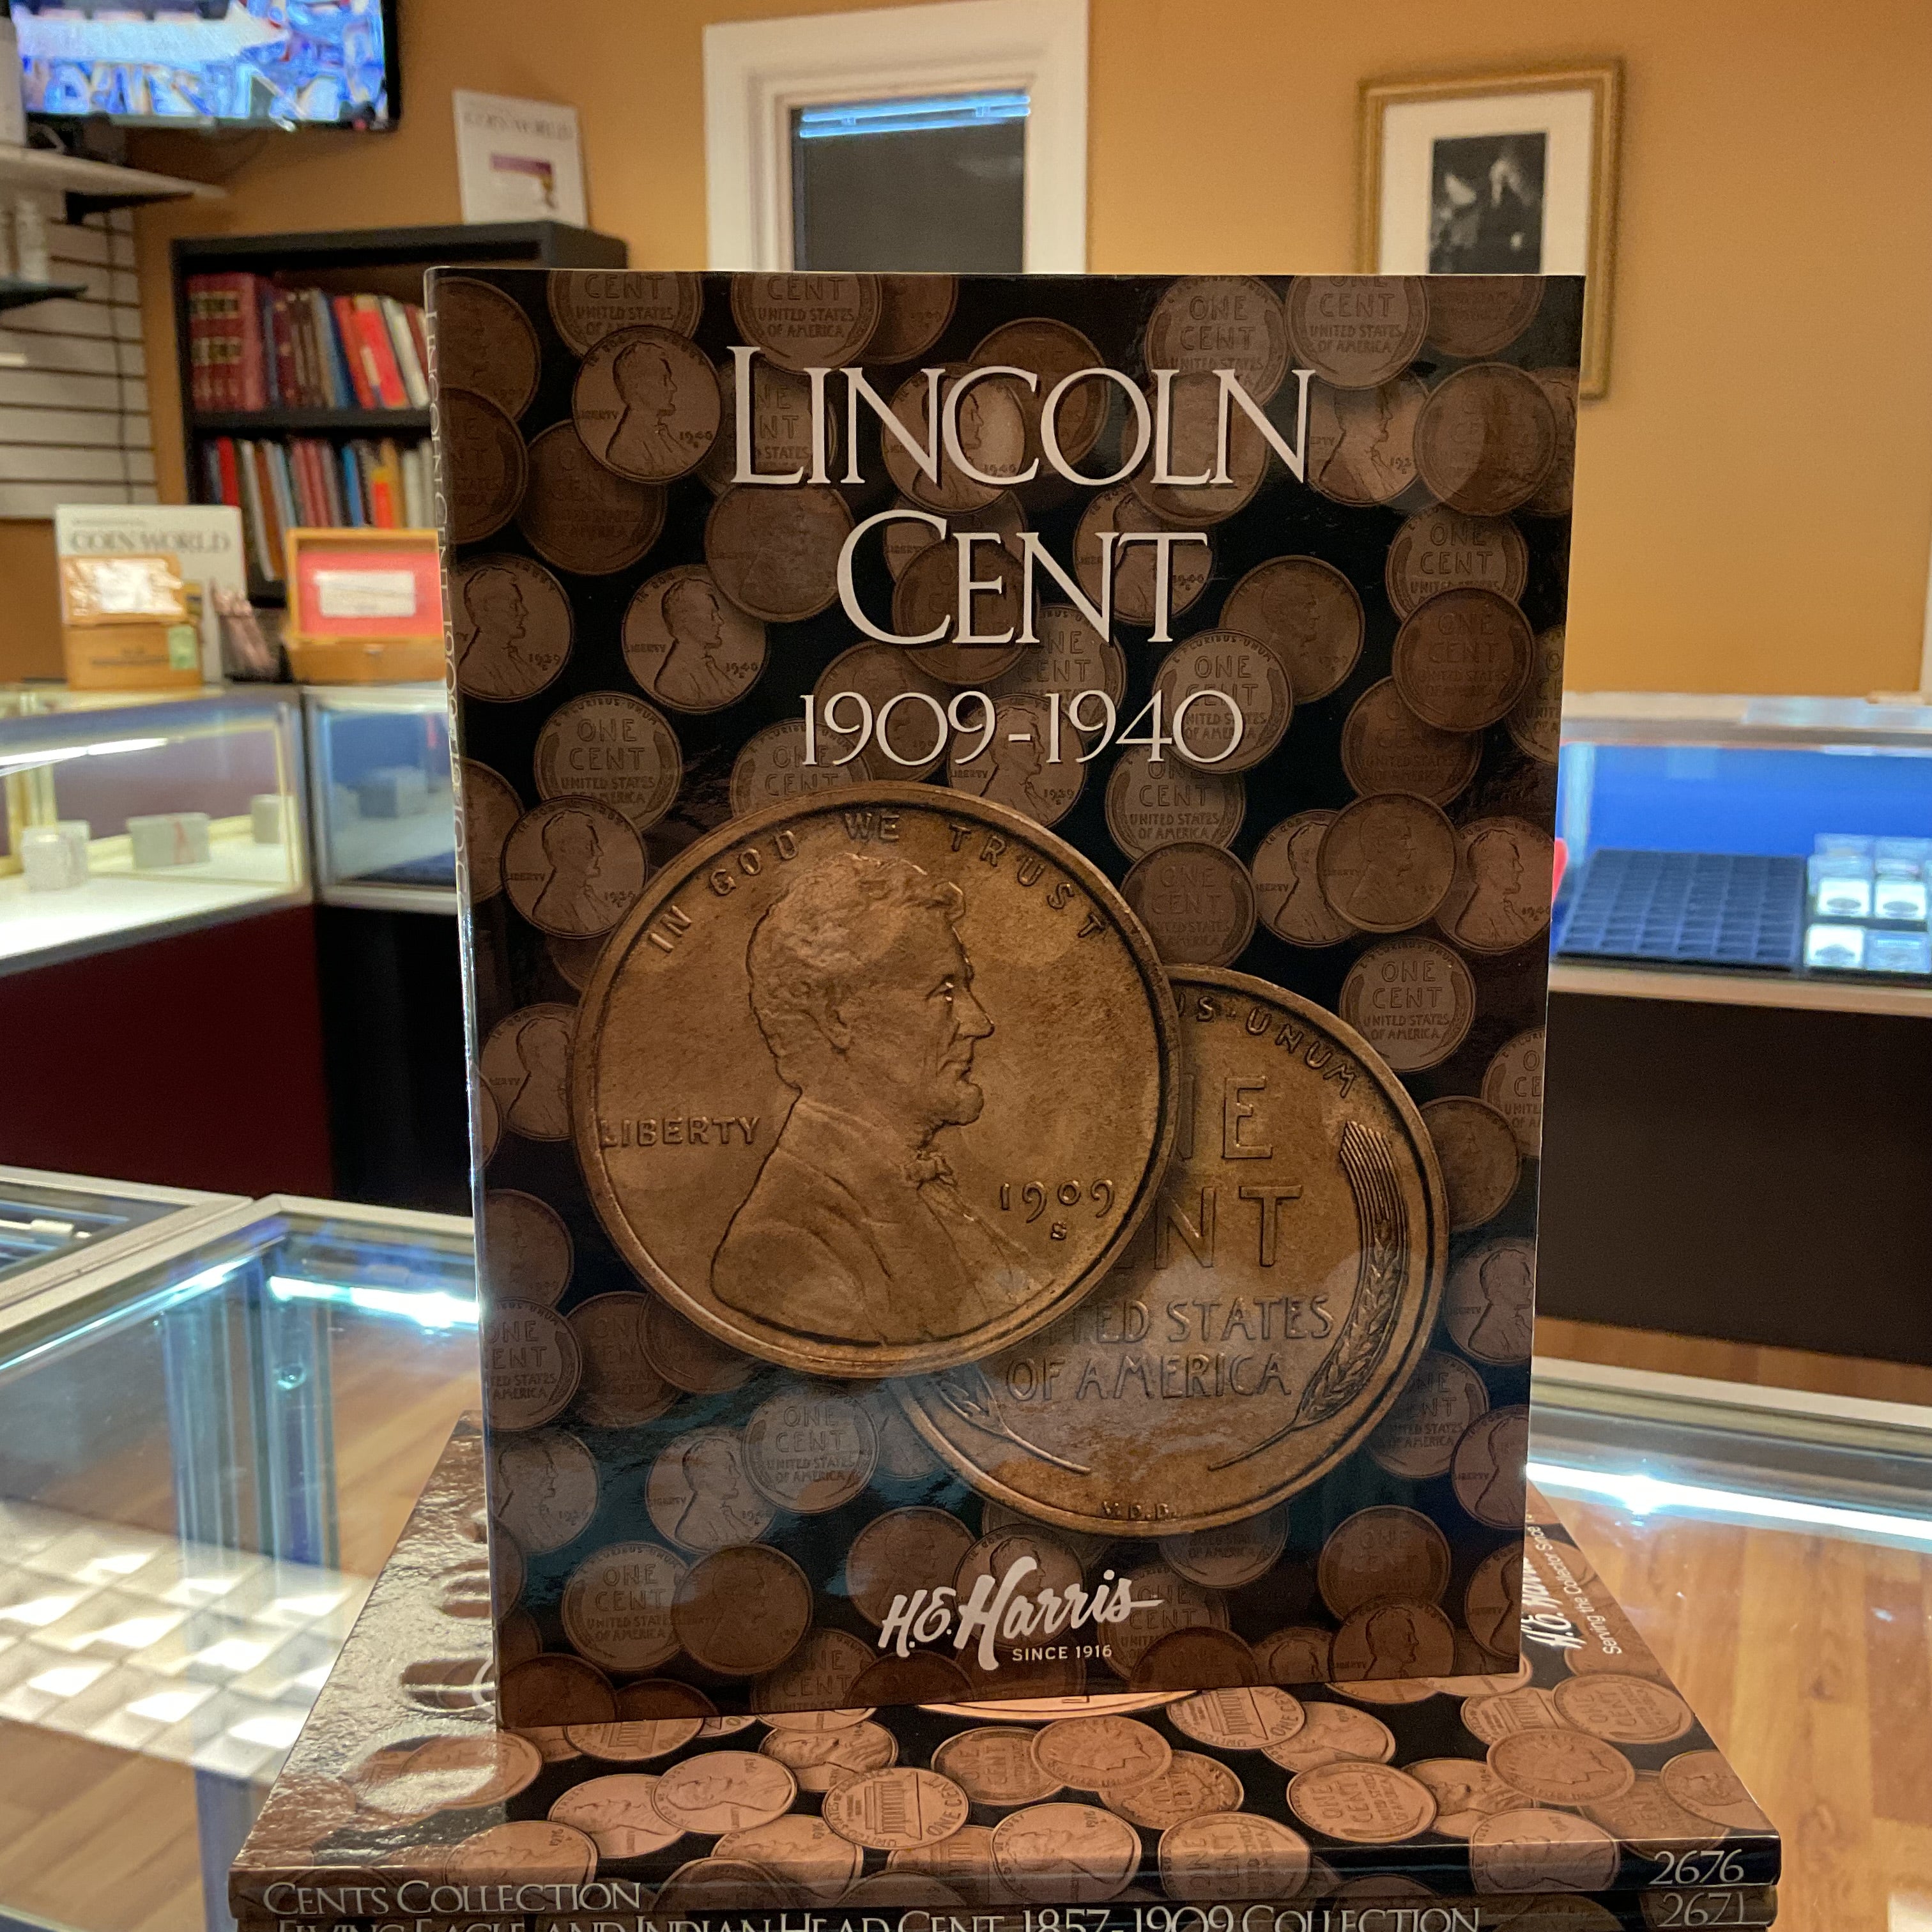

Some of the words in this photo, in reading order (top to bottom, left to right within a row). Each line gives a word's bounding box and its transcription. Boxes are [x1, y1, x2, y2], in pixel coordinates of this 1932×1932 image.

[584, 273, 665, 300] CENT
[767, 275, 846, 301] CENT
[1188, 295, 1248, 321] ONE
[1319, 293, 1395, 318] CENT
[1180, 325, 1256, 351] CENT
[727, 346, 1315, 486] LINCOLN
[1429, 522, 1487, 547] ONE
[1420, 551, 1494, 575] CENT
[837, 509, 1207, 645] CENT
[1194, 655, 1252, 678] ONE
[576, 717, 638, 743] ONE
[800, 690, 1243, 765] 1909-1940
[569, 747, 646, 771] CENT
[764, 772, 839, 796] CENT
[1138, 785, 1210, 807] CENT
[1130, 813, 1176, 825] UNITED
[648, 905, 693, 953] IN
[709, 830, 799, 896] GOD
[845, 812, 900, 842] WE
[949, 824, 1105, 938] TRUST
[1381, 960, 1436, 983] ONE
[1372, 986, 1443, 1009] CENT
[1364, 1015, 1407, 1027] UNITED
[1409, 1014, 1450, 1026] STATES
[1370, 1029, 1386, 1040] OF
[1387, 1027, 1441, 1040] AMERICA
[1246, 1008, 1358, 1098] UNUM
[598, 1117, 760, 1148] LIBERTY
[1000, 1179, 1115, 1223] 1909
[1051, 1221, 1067, 1241] S
[1167, 1295, 1334, 1342] STATES
[492, 1346, 548, 1369] ENT
[1006, 1356, 1066, 1401] OF
[1076, 1352, 1291, 1399] AMERICA
[783, 1406, 841, 1426] ONE
[775, 1430, 844, 1453] CENT
[602, 1563, 658, 1586] ONE
[595, 1589, 669, 1612] CENT
[1574, 1597, 1595, 1614] the
[953, 1556, 1165, 1671] Harris
[1128, 1609, 1197, 1630] CENT
[1587, 1614, 1622, 1655] Serving
[1012, 1646, 1068, 1660] SINCE
[1075, 1644, 1112, 1659] 1916
[923, 1775, 962, 1807] CENT
[926, 1811, 962, 1836] ONE
[1650, 1849, 1744, 1885] 2676
[263, 1881, 388, 1915] CENTS
[397, 1880, 641, 1915] COLLECTION
[1657, 1892, 1745, 1928] 2671
